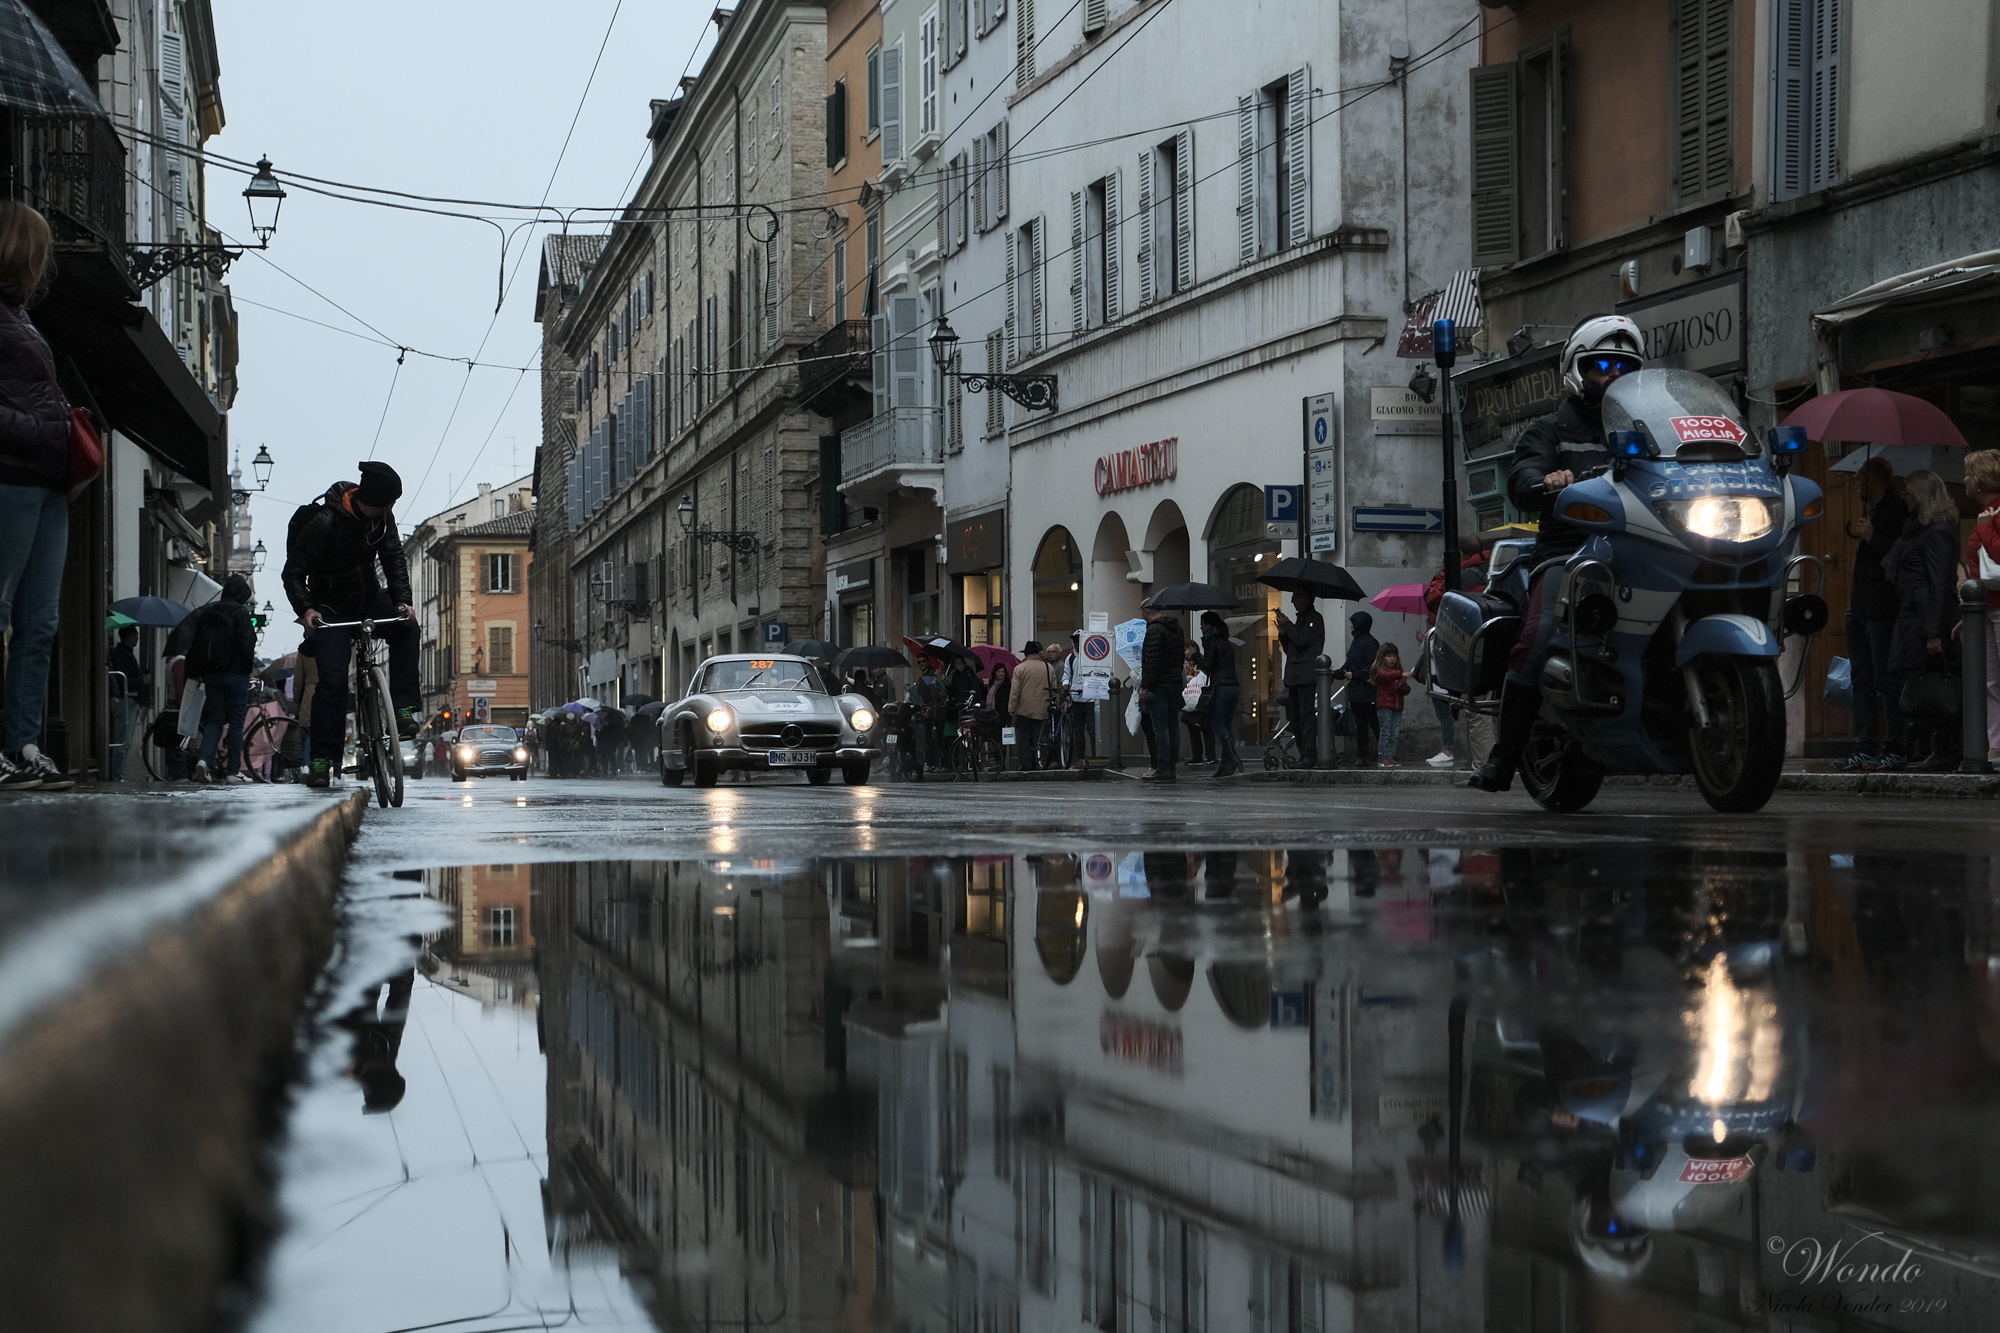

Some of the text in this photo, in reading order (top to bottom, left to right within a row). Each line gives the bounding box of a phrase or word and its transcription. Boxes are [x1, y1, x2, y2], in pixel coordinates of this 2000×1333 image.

[1640, 308, 1732, 361] REZIOSO
[1376, 406, 1414, 415] GIACOMO
[1679, 418, 1726, 428] 1000
[1682, 429, 1736, 440] MIGLIA
[1664, 461, 1764, 476] POLIZIA
[1648, 476, 1783, 498] STRADALE
[1272, 489, 1292, 518] P
[769, 624, 781, 641] P
[750, 660, 775, 669] 287
[775, 753, 786, 762] NR
